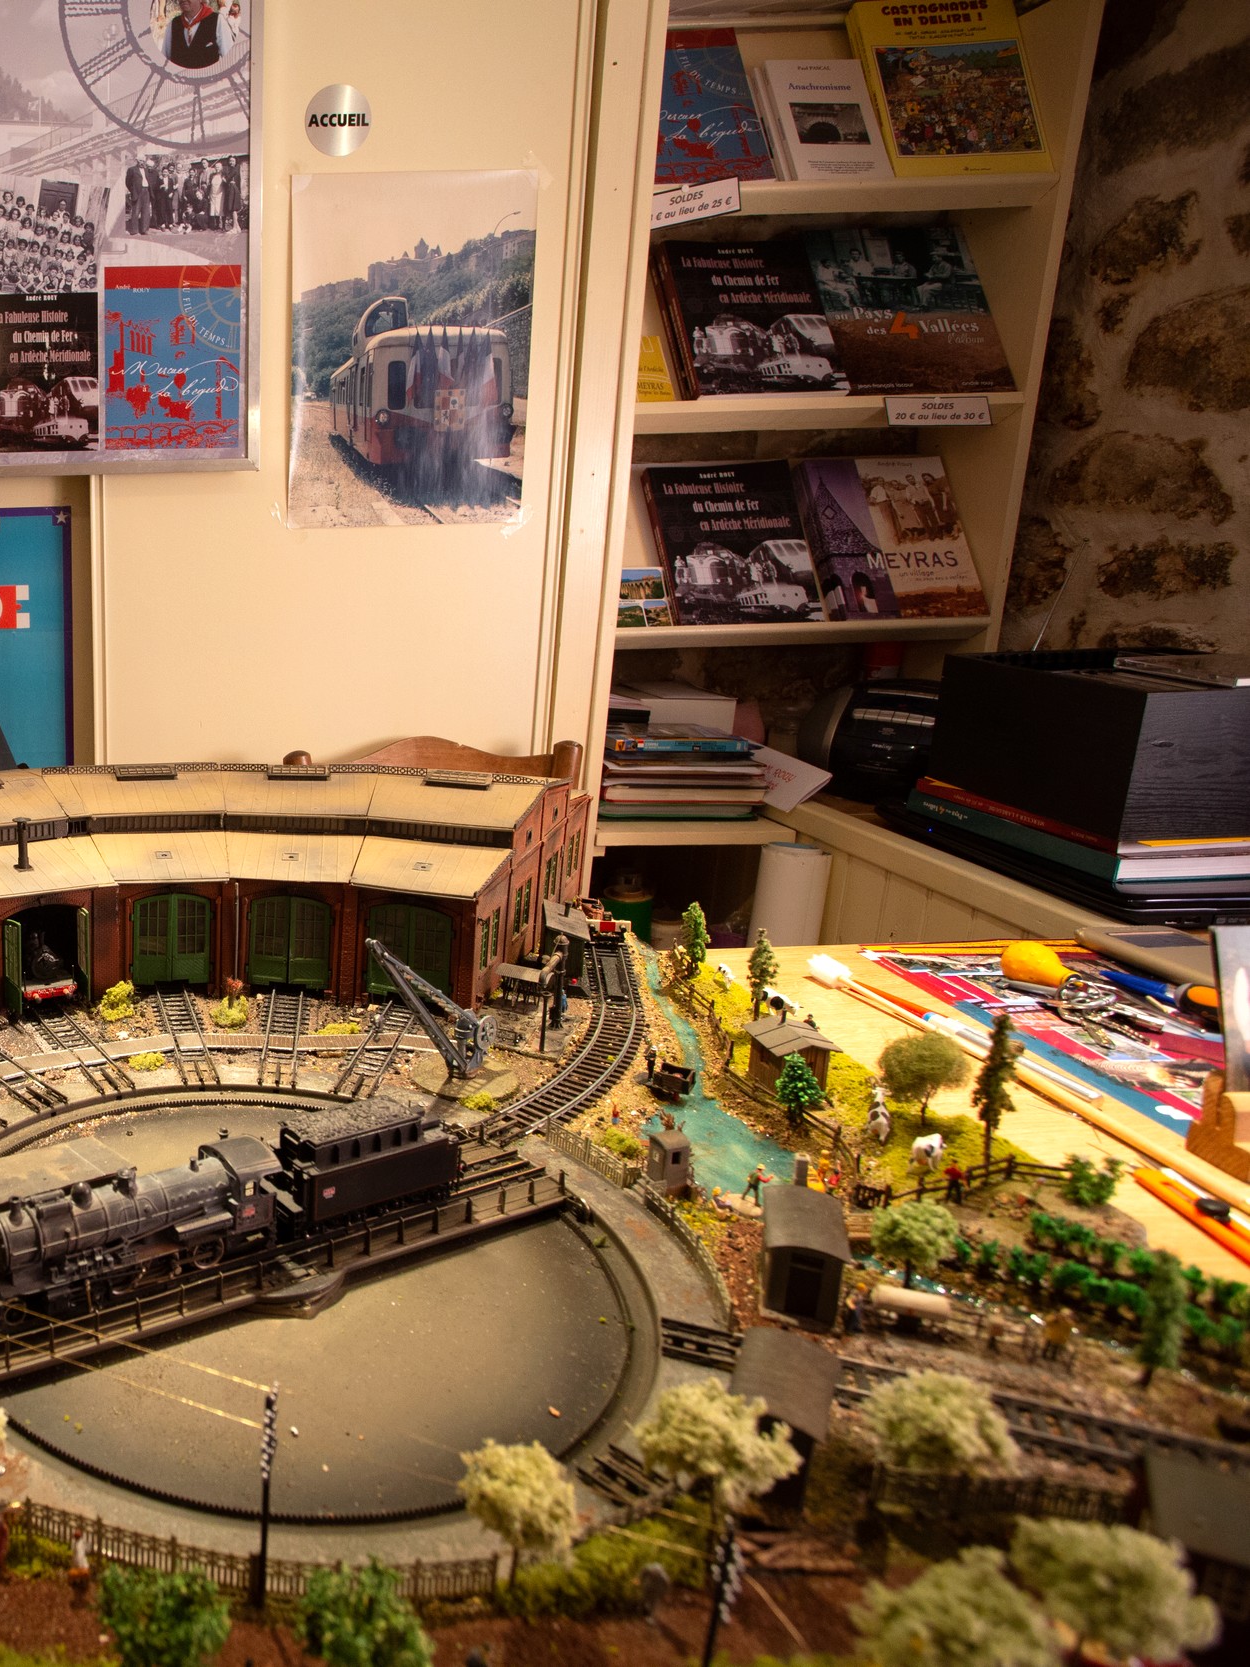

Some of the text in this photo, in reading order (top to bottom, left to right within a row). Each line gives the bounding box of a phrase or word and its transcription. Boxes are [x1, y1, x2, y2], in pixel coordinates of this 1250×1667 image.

[881, 0, 988, 16] CASTAGNADES
[893, 17, 913, 27] EN
[788, 83, 851, 91] Anachronisme
[308, 113, 369, 127] ACCUEIL
[669, 190, 704, 206] SOLDES
[656, 212, 663, 221] €
[665, 211, 676, 219] au
[678, 206, 696, 216] lieu
[697, 202, 710, 212] de
[711, 199, 723, 209] 25
[725, 196, 733, 206] €
[681, 256, 692, 268] La
[692, 257, 731, 269] Fabuleuse
[732, 257, 765, 269] Histoire
[711, 274, 780, 286] du Chemin de Fer
[719, 291, 811, 304] en Ardèche Méridionale
[4, 310, 40, 324] Fabuleuse
[41, 310, 69, 323] Histoire
[182, 297, 192, 313] FIL
[189, 314, 200, 328] DU
[852, 306, 893, 323] Pays
[866, 311, 980, 340] des 4 Vallées
[12, 329, 73, 344] du Chemin de Fer
[10, 349, 91, 363] en Ardèche Méridionale
[636, 382, 664, 390] MEYRAS
[921, 402, 955, 410] SOLDES
[931, 412, 948, 420] lieu
[950, 412, 961, 420] de
[963, 412, 975, 420] 30
[978, 412, 985, 420] €
[663, 483, 673, 495] La
[674, 482, 713, 495] Fabuleuse
[713, 482, 746, 494] Histoire
[692, 499, 759, 513] du Chemin de Fer
[700, 516, 791, 531] en Ardèche Méridionale
[866, 550, 959, 570] MEYRAS
[909, 569, 934, 577] village
